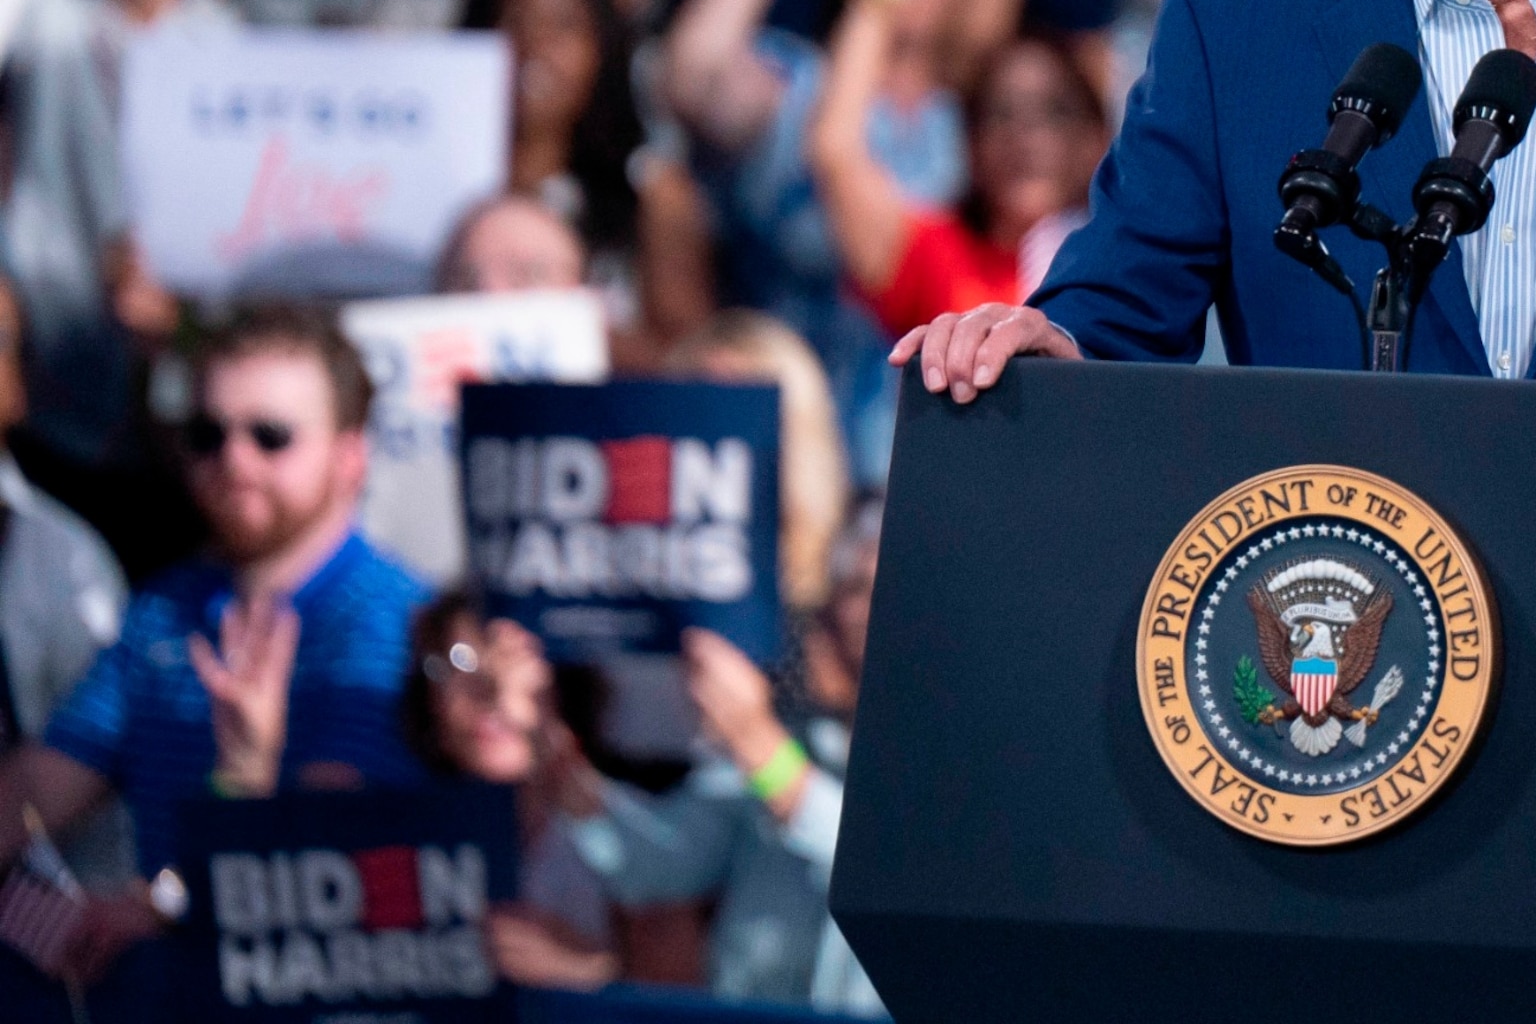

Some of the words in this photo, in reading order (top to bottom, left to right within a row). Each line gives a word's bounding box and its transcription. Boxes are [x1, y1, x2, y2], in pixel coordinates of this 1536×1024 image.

[468, 434, 752, 526] BIDEN
[1326, 482, 1358, 507] OF
[1364, 492, 1408, 530] THE
[472, 522, 752, 603] HARRIS
[1151, 479, 1314, 641] PRESIDENT
[1413, 527, 1481, 682] UNITED
[1153, 655, 1179, 708] THE
[1165, 713, 1191, 746] OF
[1188, 743, 1277, 825] SEAL
[1339, 715, 1462, 828] STATES
[210, 843, 488, 933] BIDEN
[220, 922, 495, 1006] HARRIS
